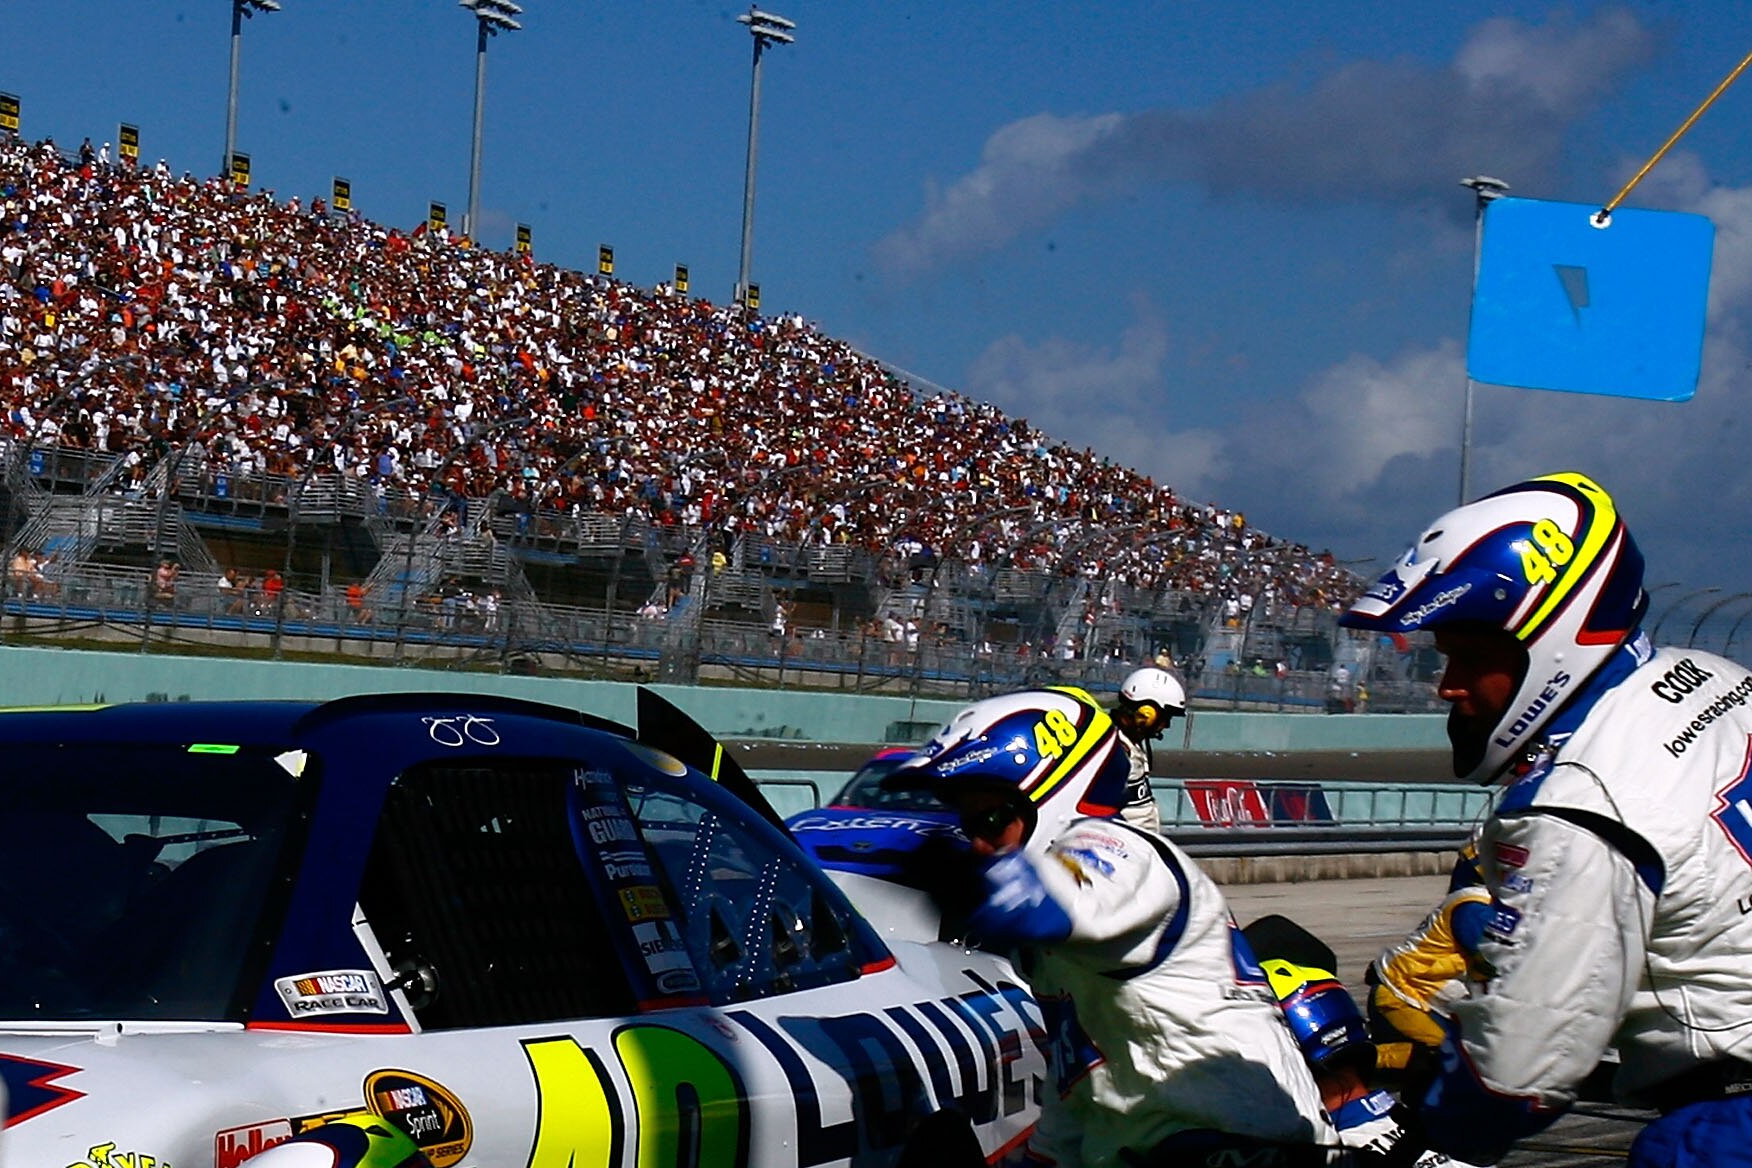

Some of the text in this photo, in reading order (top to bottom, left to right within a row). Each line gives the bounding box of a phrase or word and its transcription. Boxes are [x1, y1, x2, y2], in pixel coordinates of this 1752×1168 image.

[1519, 518, 1576, 587] 48
[1651, 657, 1714, 704] COOK
[1495, 669, 1572, 749] LOWE'S
[1033, 708, 1079, 761] 48
[294, 997, 380, 1011] RACE CAR
[317, 975, 368, 994] NASCAR
[391, 1086, 427, 1110] NASCAR
[406, 1109, 441, 1140] Sprint
